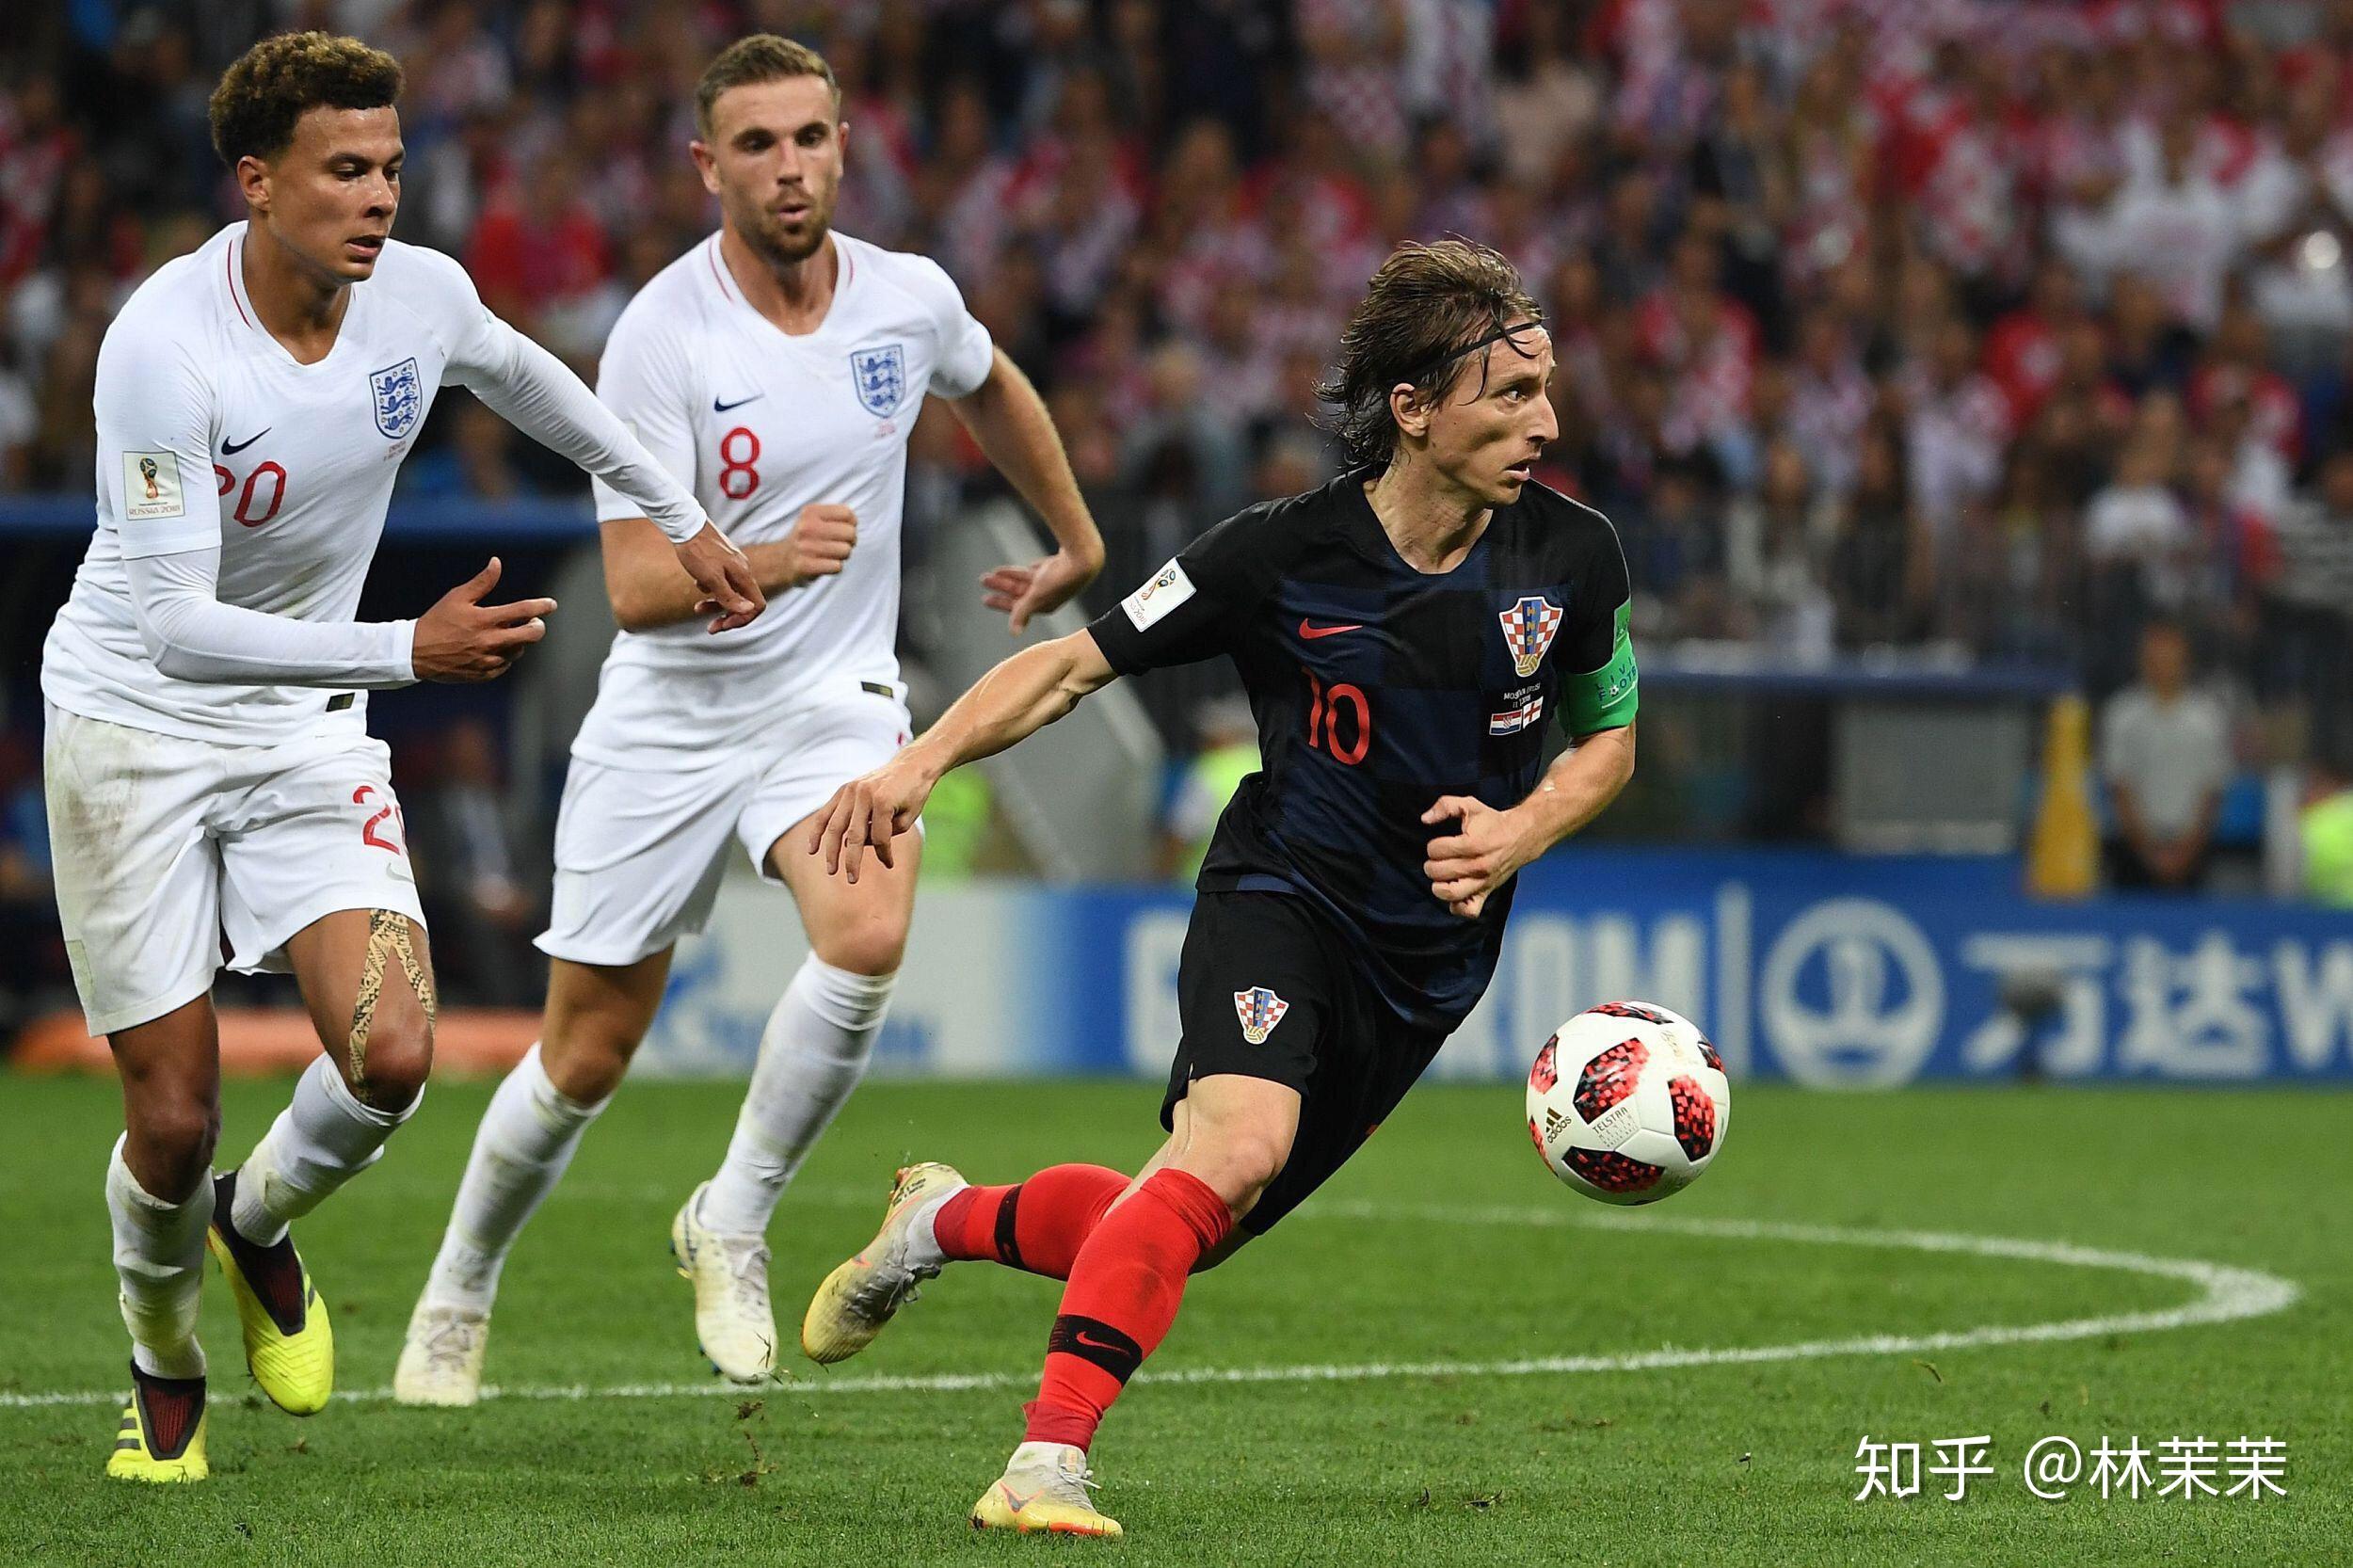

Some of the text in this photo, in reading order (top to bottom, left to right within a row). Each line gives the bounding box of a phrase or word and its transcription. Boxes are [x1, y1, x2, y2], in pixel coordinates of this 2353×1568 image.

[719, 427, 760, 500] 8
[1301, 666, 1370, 765] 10
[1547, 1115, 1572, 1144] adidas
[1593, 1106, 1628, 1134] TELSTAR
